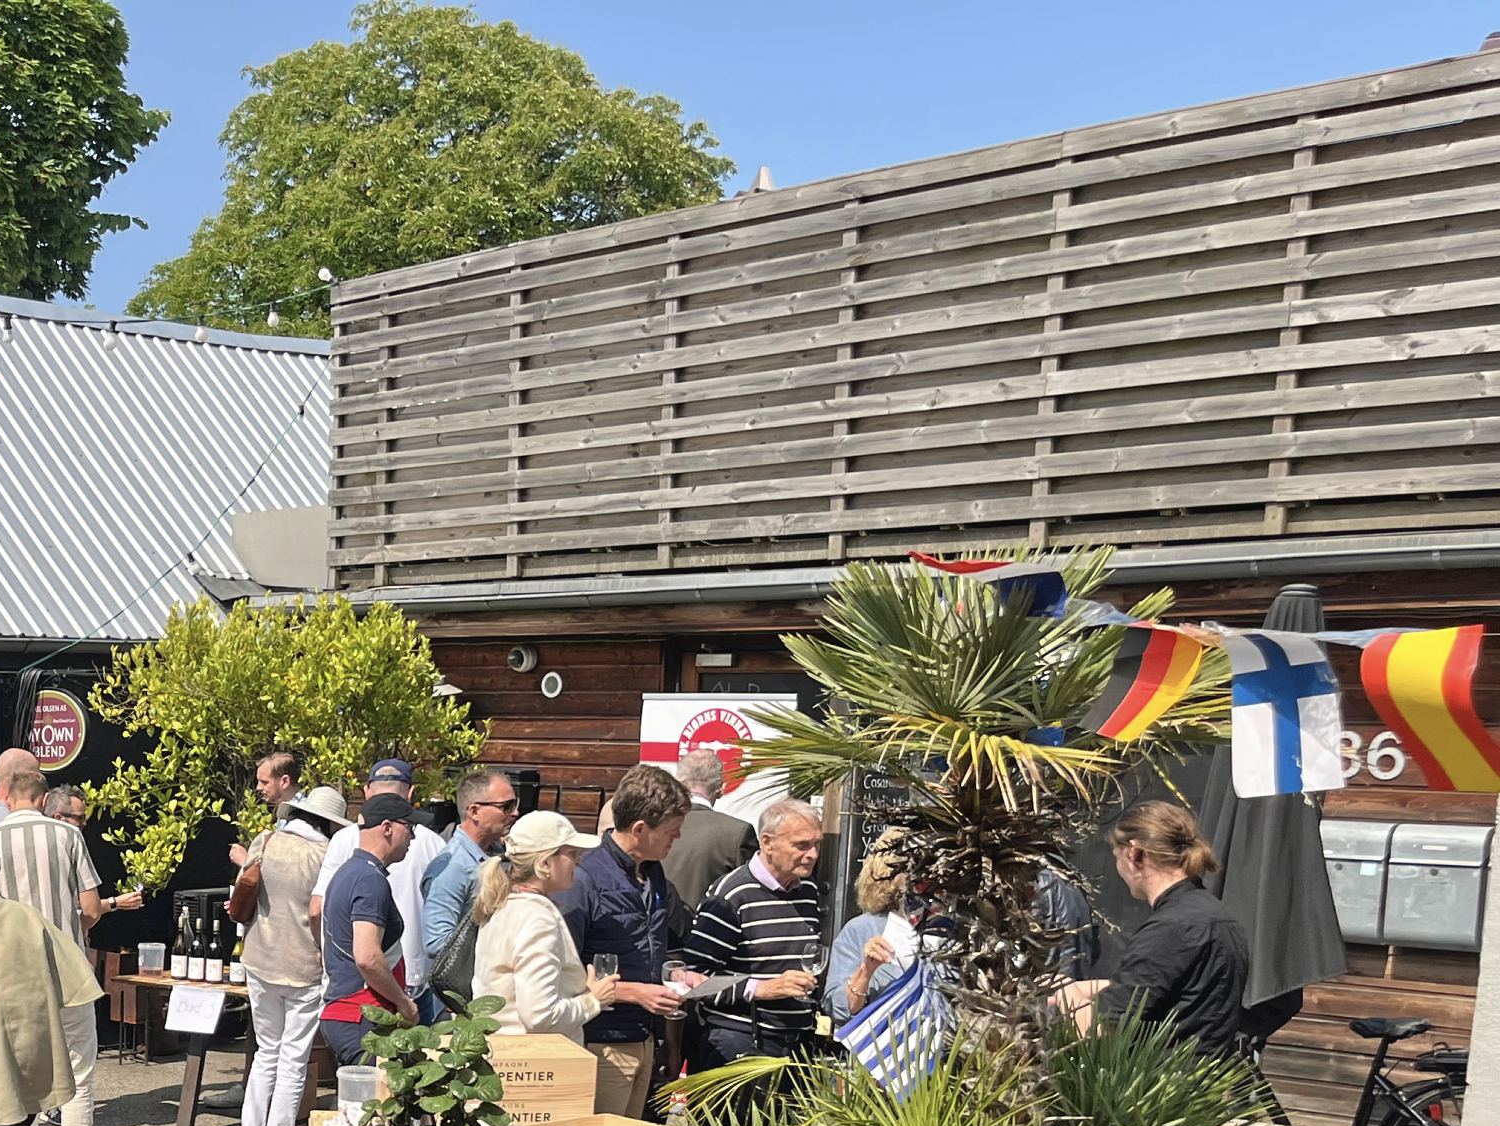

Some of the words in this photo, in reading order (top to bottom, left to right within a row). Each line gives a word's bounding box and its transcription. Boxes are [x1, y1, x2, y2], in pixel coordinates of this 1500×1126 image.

[43, 704, 60, 713] OLSEN
[60, 704, 67, 712] AS
[41, 725, 74, 745] OWN
[33, 745, 66, 758] BLEND
[202, 993, 219, 1019] 3
[511, 1112, 551, 1122] NTIER
